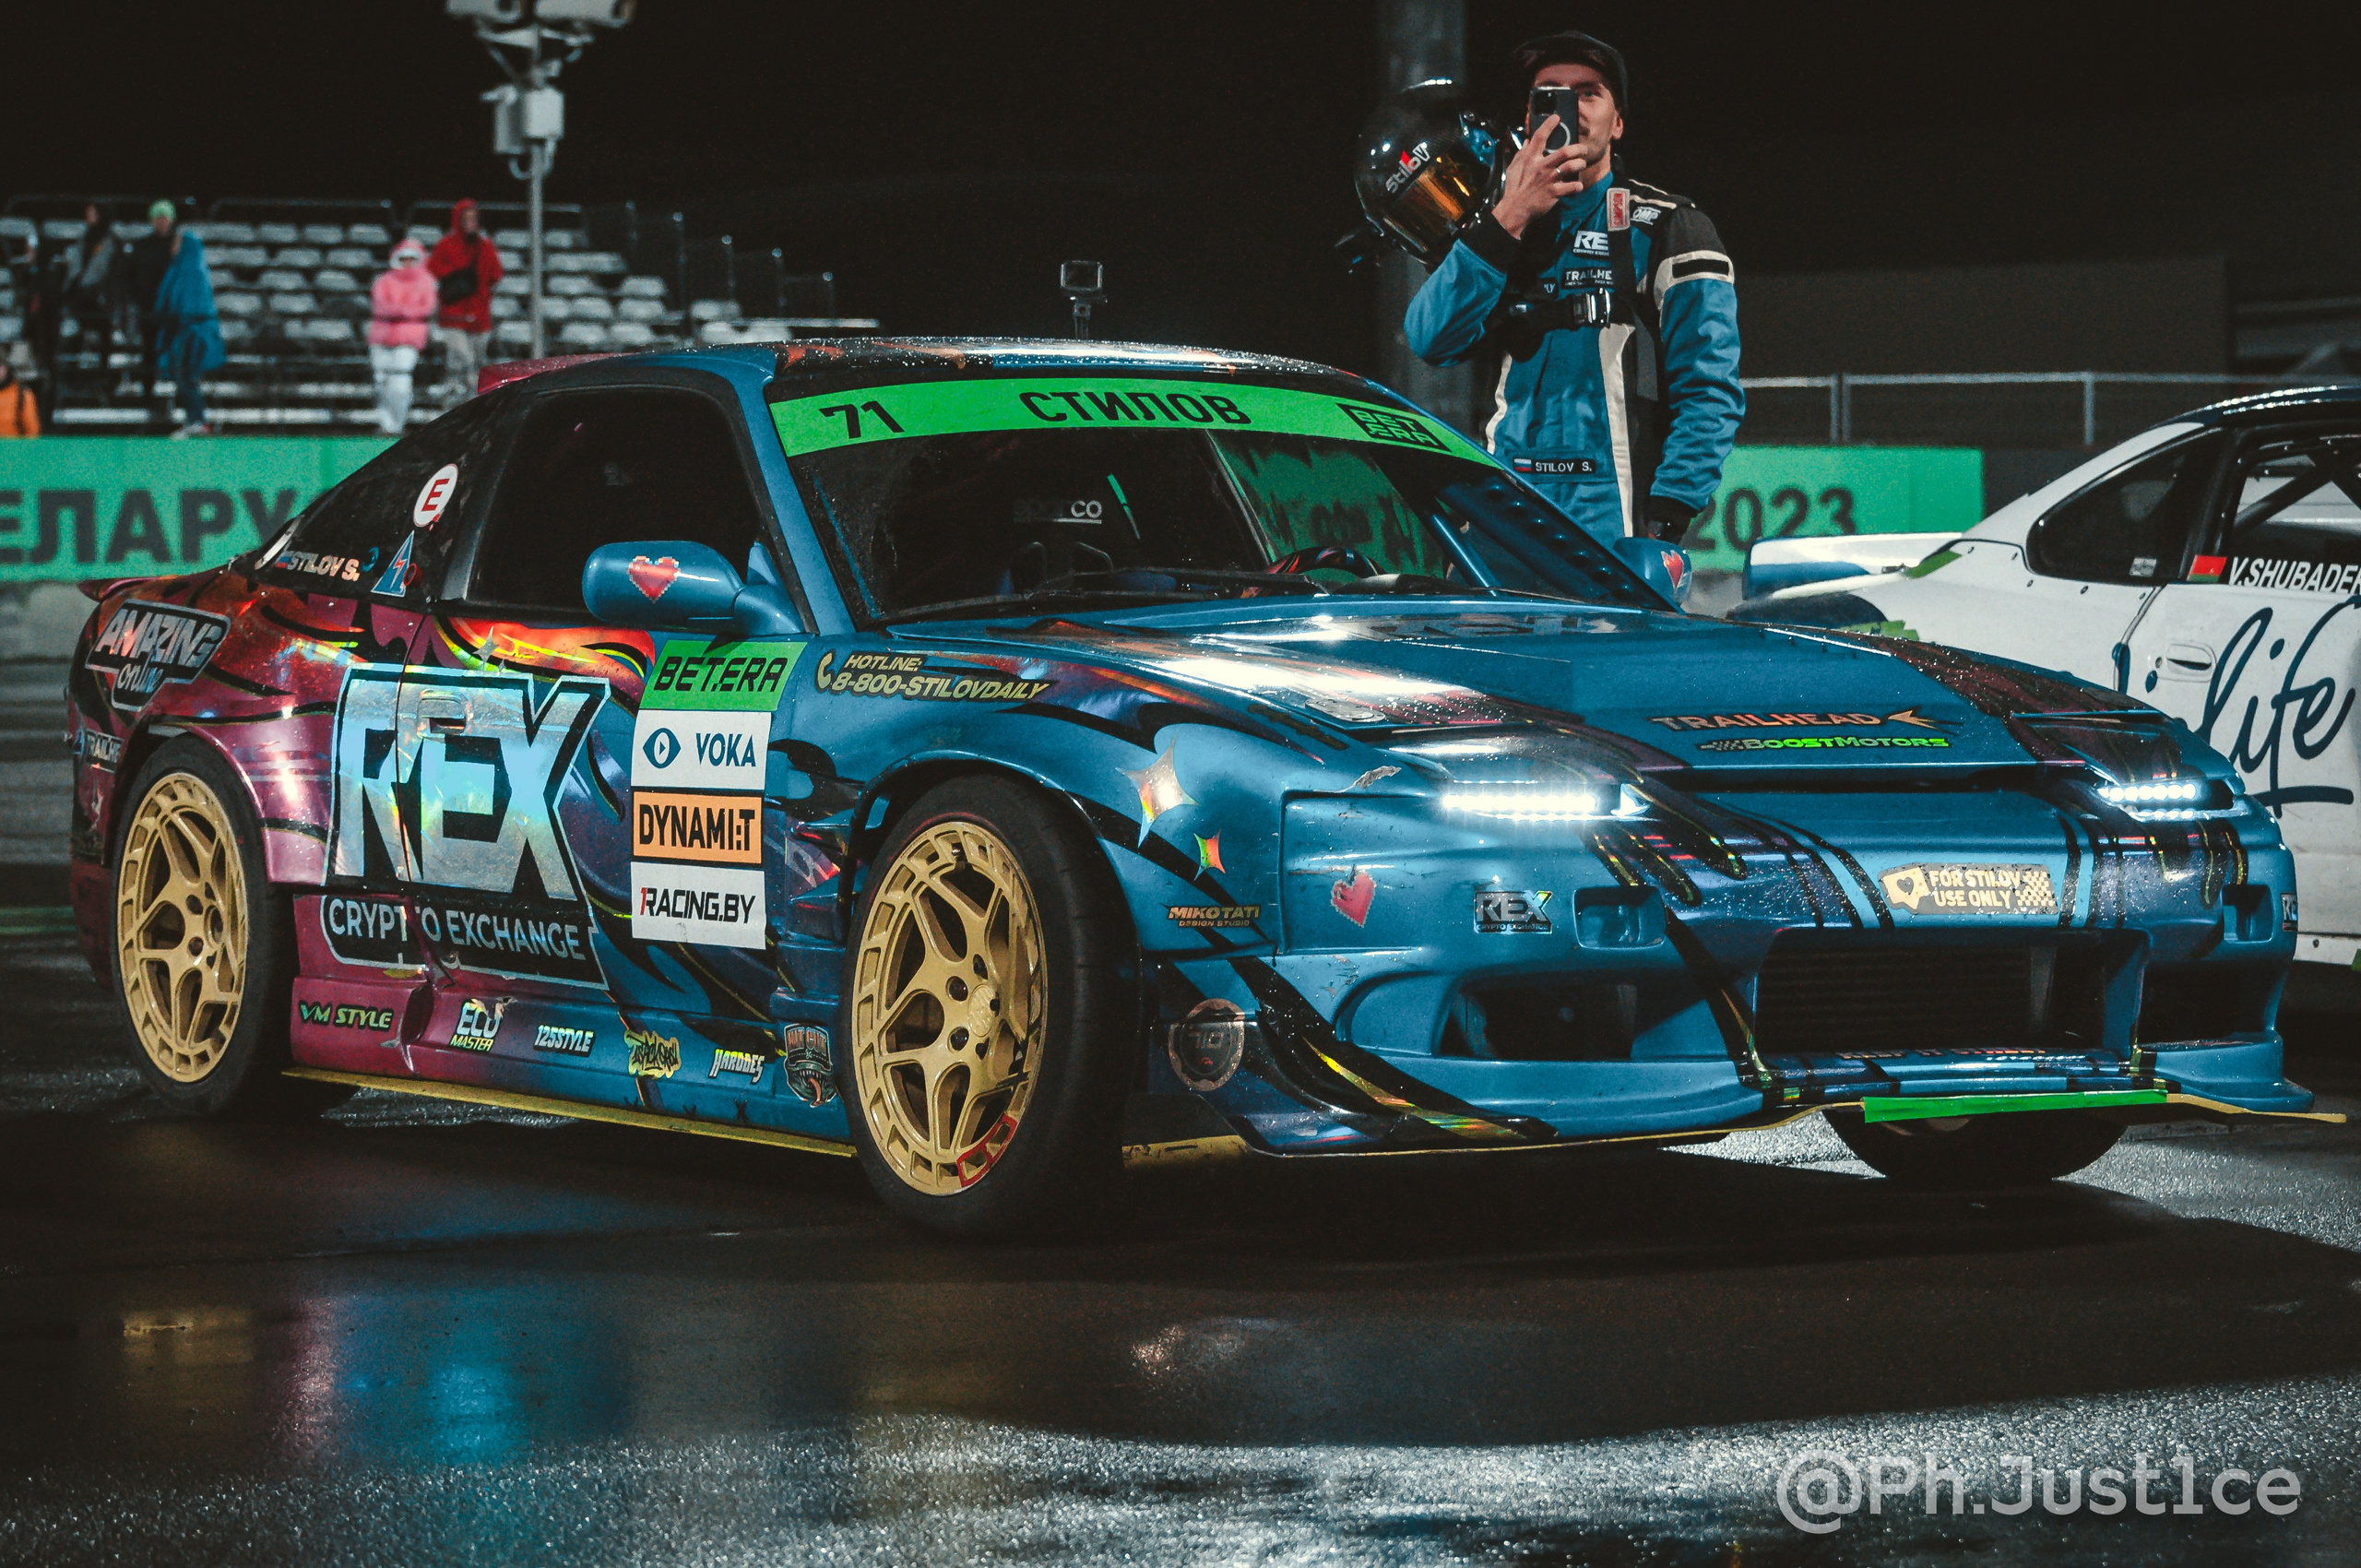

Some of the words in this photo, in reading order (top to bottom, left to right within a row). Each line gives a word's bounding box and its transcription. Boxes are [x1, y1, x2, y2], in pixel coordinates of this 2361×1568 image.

[819, 400, 905, 439] 71
[1018, 391, 1252, 425] СТИЛОВ
[1536, 462, 1574, 472] STILOV
[1582, 461, 1593, 472] S.
[421, 478, 450, 512] E
[1677, 487, 1857, 553] 2023
[286, 551, 346, 577] STILOV
[341, 559, 361, 582] S.
[94, 608, 223, 669] AMAZING
[843, 654, 922, 671] HOTLINE:
[831, 671, 1050, 699] 8-800-STILOVDAILY
[1650, 713, 1881, 731] TRAILHEAD
[2195, 595, 2361, 819] life
[695, 732, 757, 767] VOKA
[335, 678, 591, 901] REX
[1928, 870, 1964, 887] FOR
[1965, 871, 2021, 888] STILOV
[640, 887, 756, 924] 1RACING.BY
[1168, 906, 1260, 920] MIKOTATI
[1476, 891, 1551, 922] REX
[1932, 890, 1967, 907] USE
[1968, 890, 2011, 907] ONLY
[328, 897, 442, 942] CRYPTO
[445, 909, 587, 960] EXCHANGE
[300, 1004, 332, 1022] VM
[335, 1007, 393, 1028] STYLE
[450, 1034, 494, 1051] MASTER
[534, 1024, 595, 1052] 125STYLE
